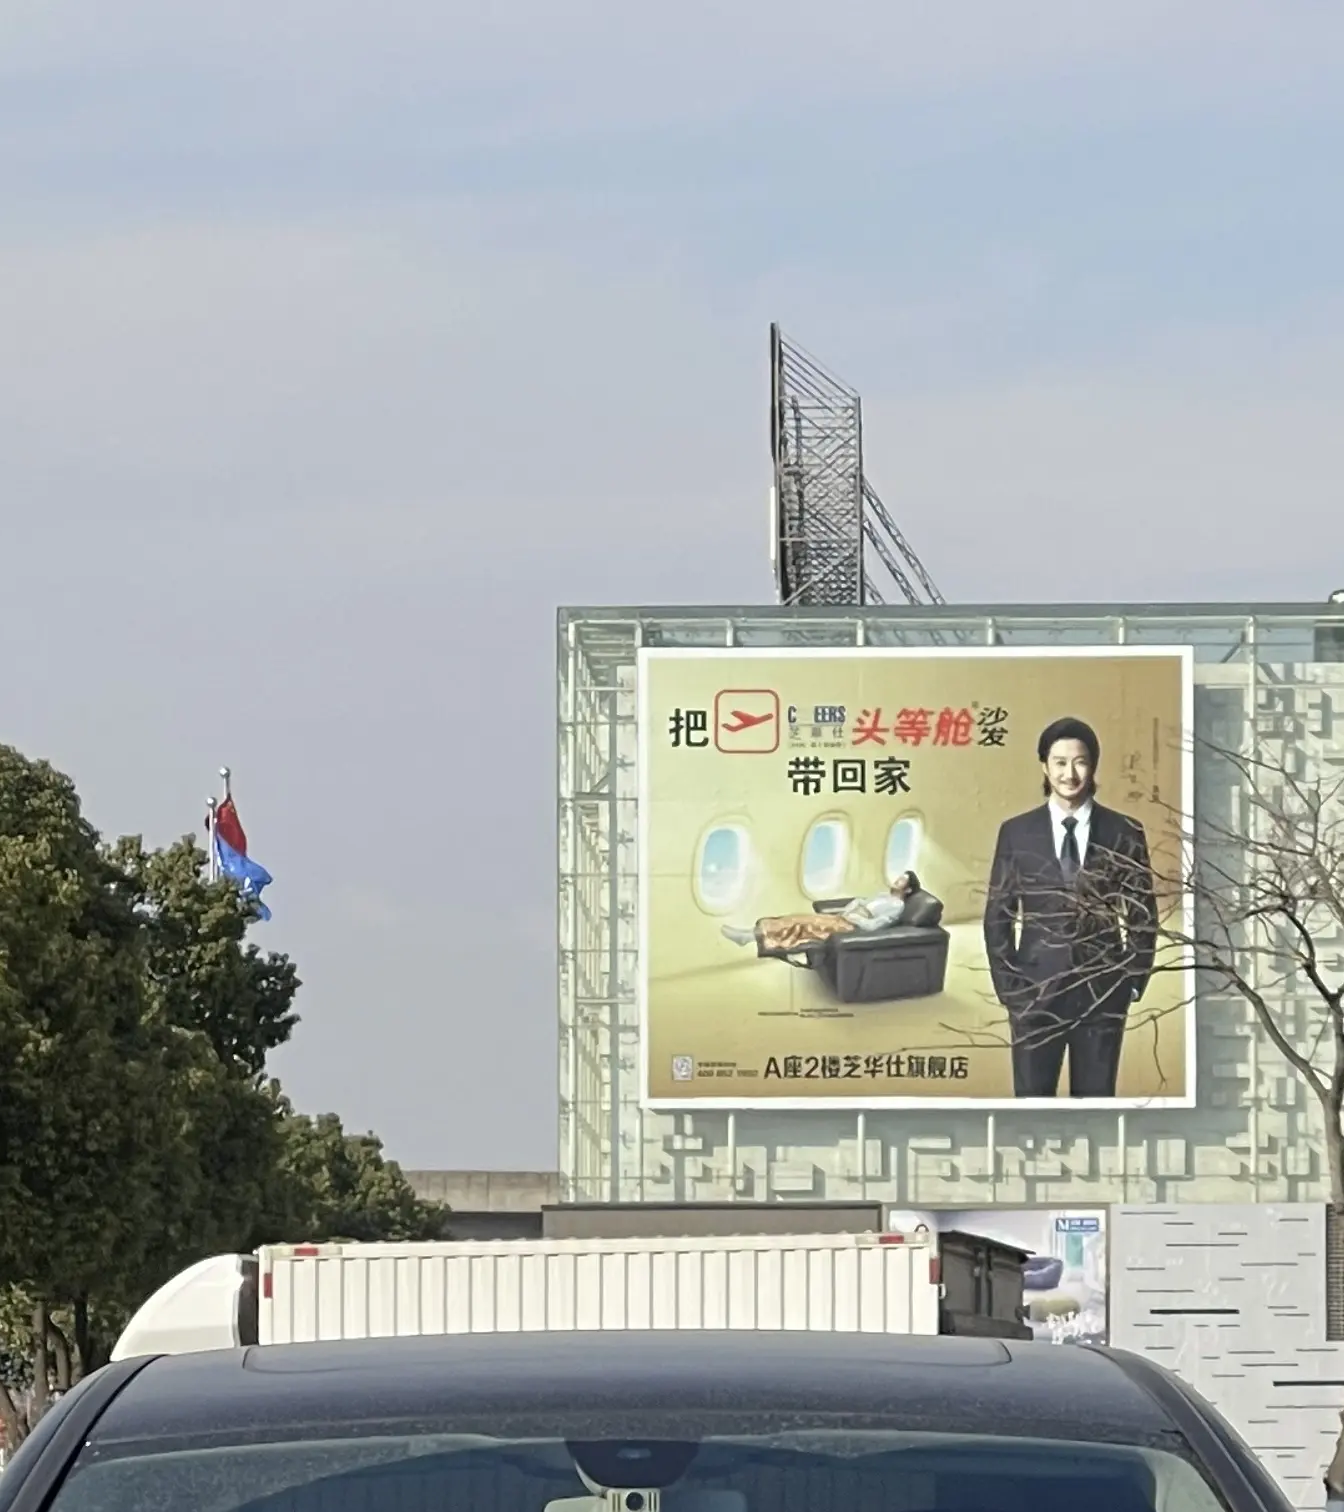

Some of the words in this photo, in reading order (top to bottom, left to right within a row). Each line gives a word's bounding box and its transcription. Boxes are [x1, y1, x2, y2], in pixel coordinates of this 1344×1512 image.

[669, 708, 708, 747] 把
[787, 705, 846, 723] CEERS
[852, 706, 974, 746] 头等舱
[977, 706, 1009, 746] 沙发
[787, 756, 911, 795] 带回家
[764, 1054, 969, 1079] A座2楼芝华仕旗舰店
